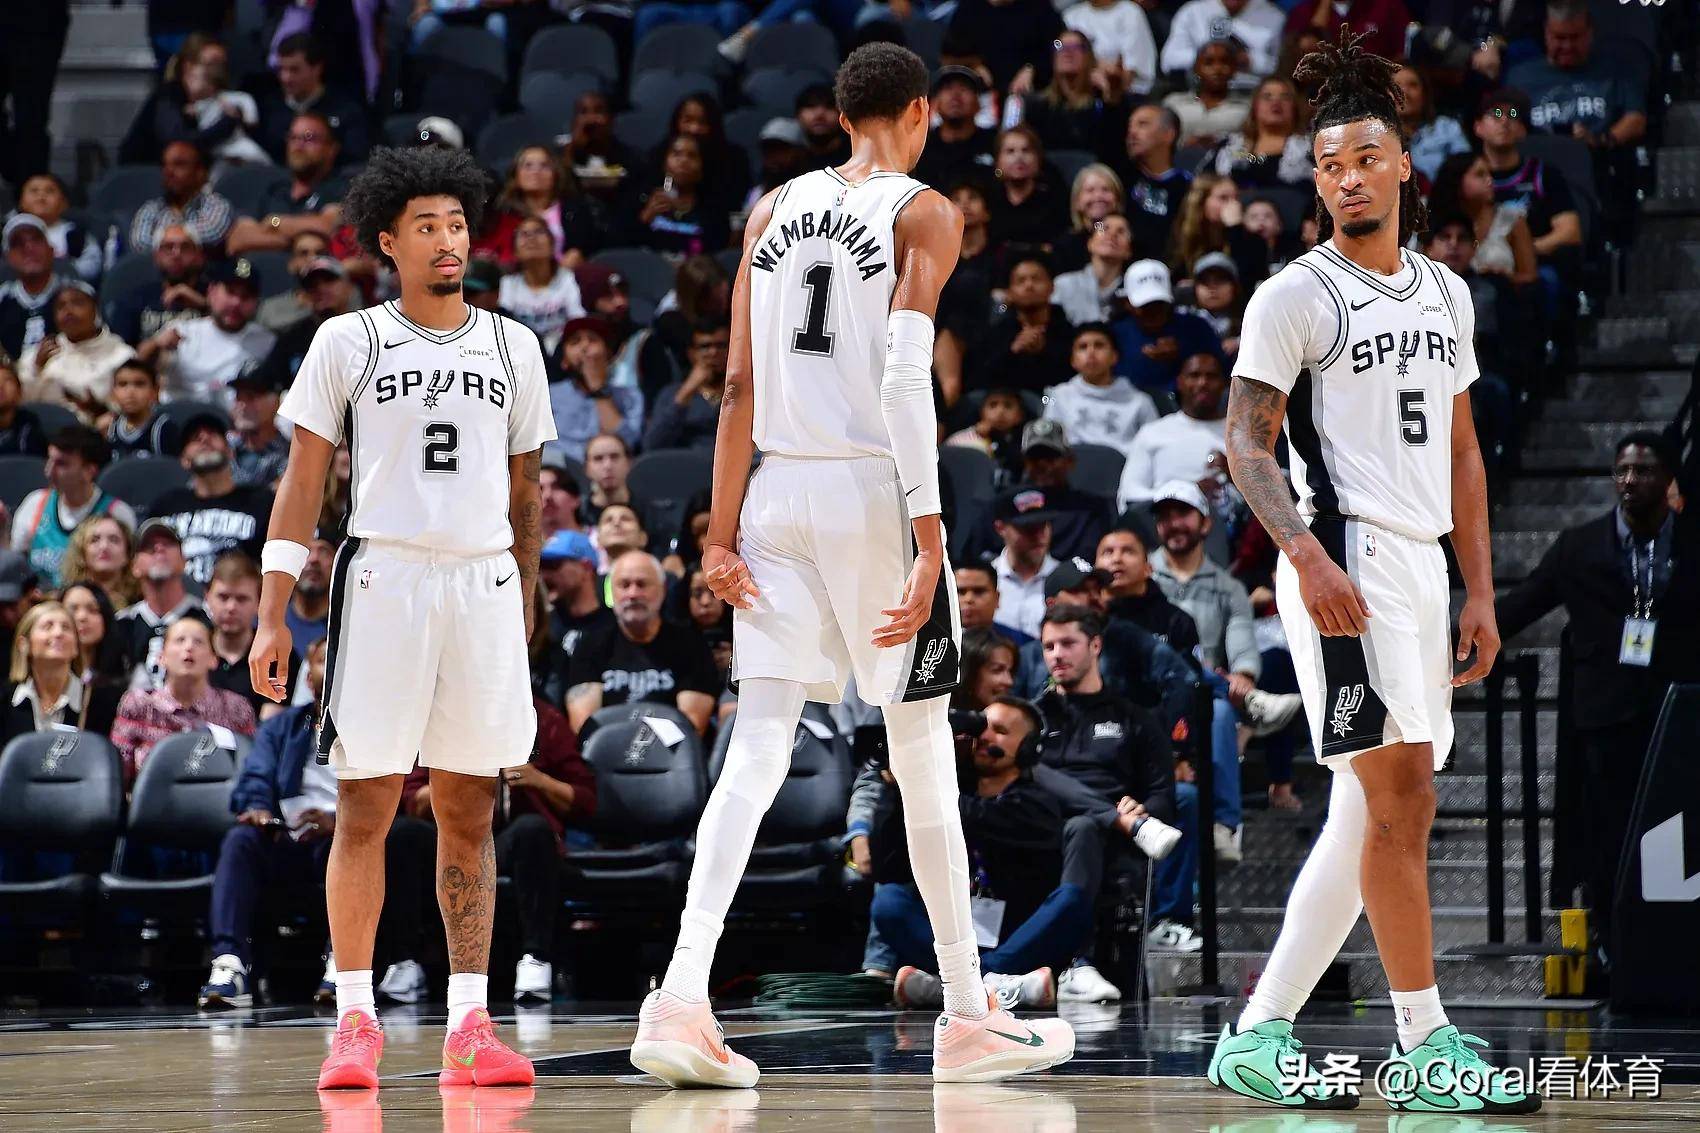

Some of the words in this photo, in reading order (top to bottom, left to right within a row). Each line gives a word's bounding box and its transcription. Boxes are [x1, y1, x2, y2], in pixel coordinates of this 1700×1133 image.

[790, 260, 836, 358] 1
[375, 369, 506, 410] SPURS
[1397, 388, 1430, 446] 5
[422, 420, 460, 474] 2
